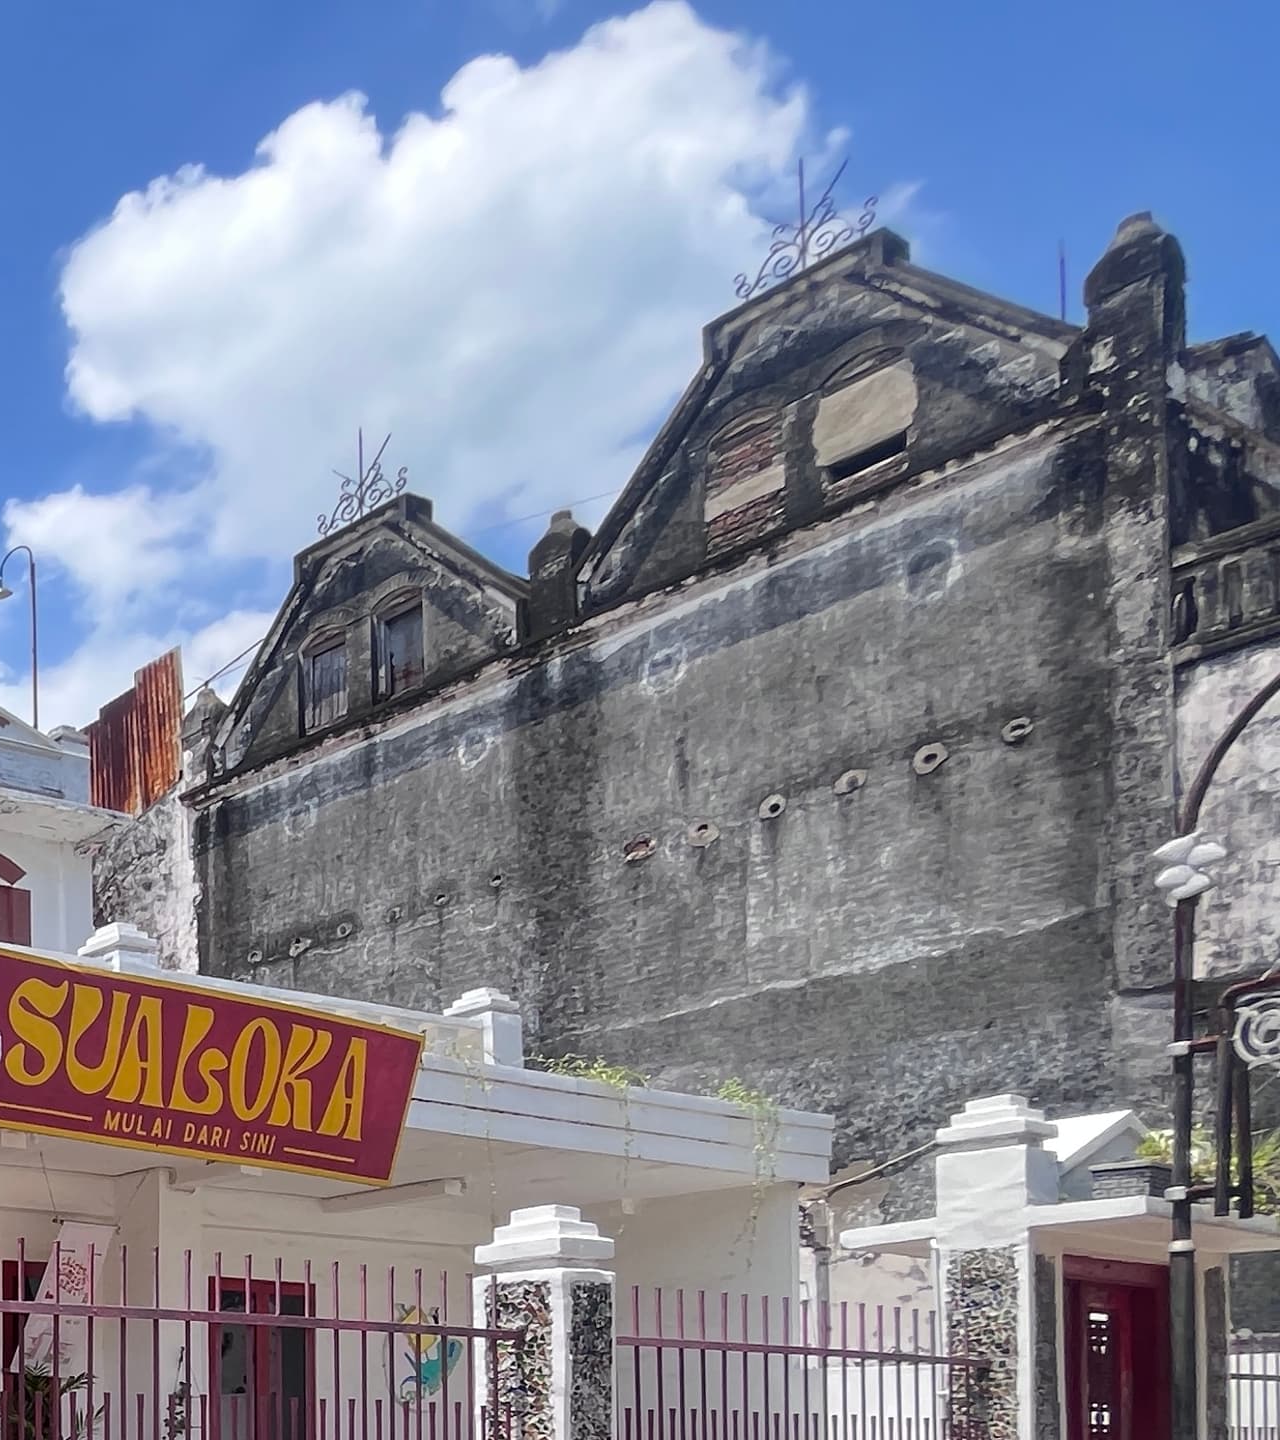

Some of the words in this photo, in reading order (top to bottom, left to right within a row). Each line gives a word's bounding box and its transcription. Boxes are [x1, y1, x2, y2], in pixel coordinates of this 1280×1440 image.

[4, 976, 369, 1142] SUALOKA
[103, 1110, 172, 1140] MULAI
[183, 1122, 231, 1149] DARI
[239, 1131, 277, 1156] SINI
